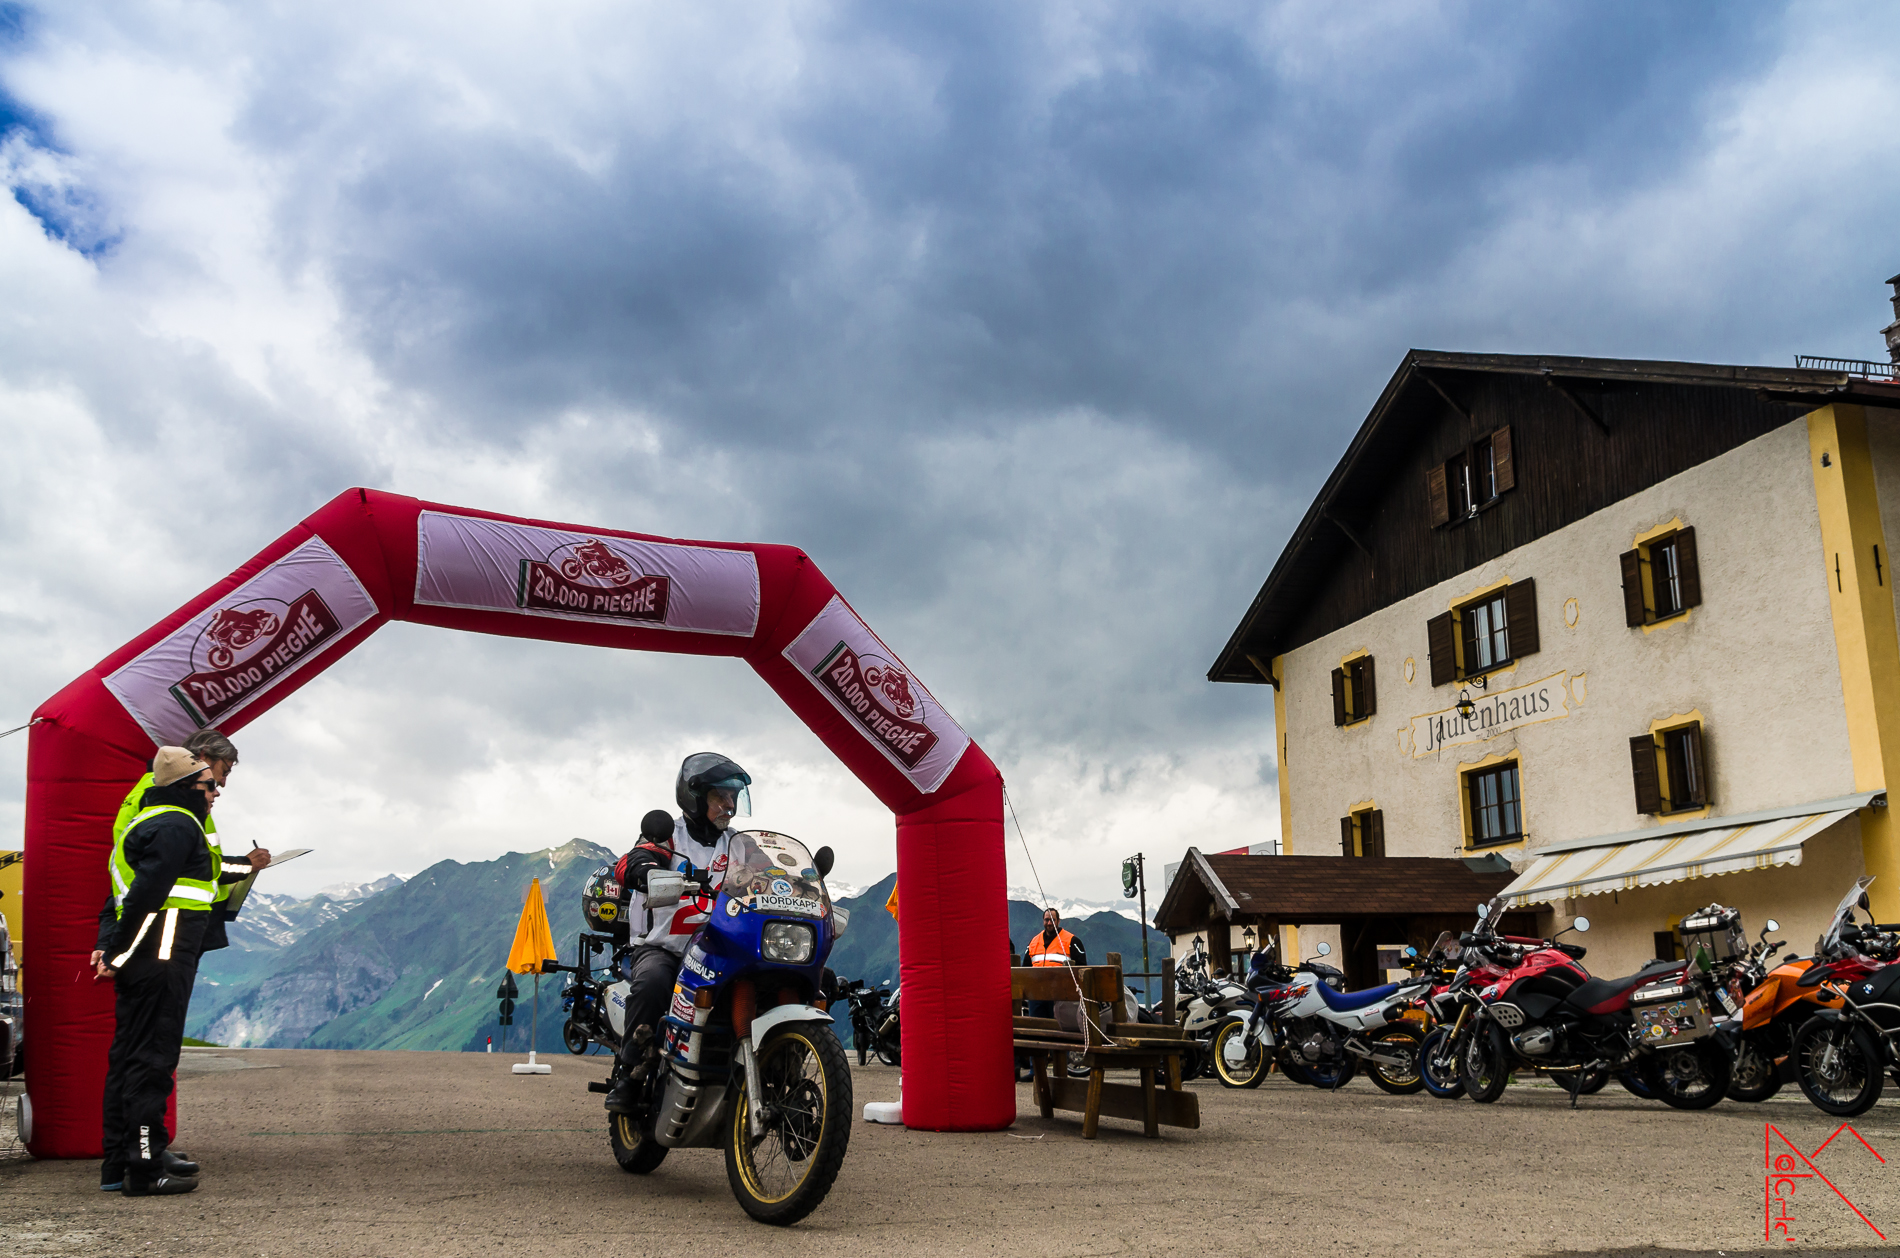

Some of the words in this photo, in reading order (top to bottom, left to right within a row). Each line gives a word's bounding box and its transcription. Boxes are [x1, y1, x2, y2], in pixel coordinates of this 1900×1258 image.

[533, 568, 589, 609] 20.000
[592, 582, 657, 613] PIEGHE
[191, 666, 262, 707] 20.000
[261, 603, 324, 673] PIEGHE
[831, 656, 870, 714] 20.000
[865, 710, 927, 755] PIEGHE
[761, 896, 817, 910] NORDKAPP
